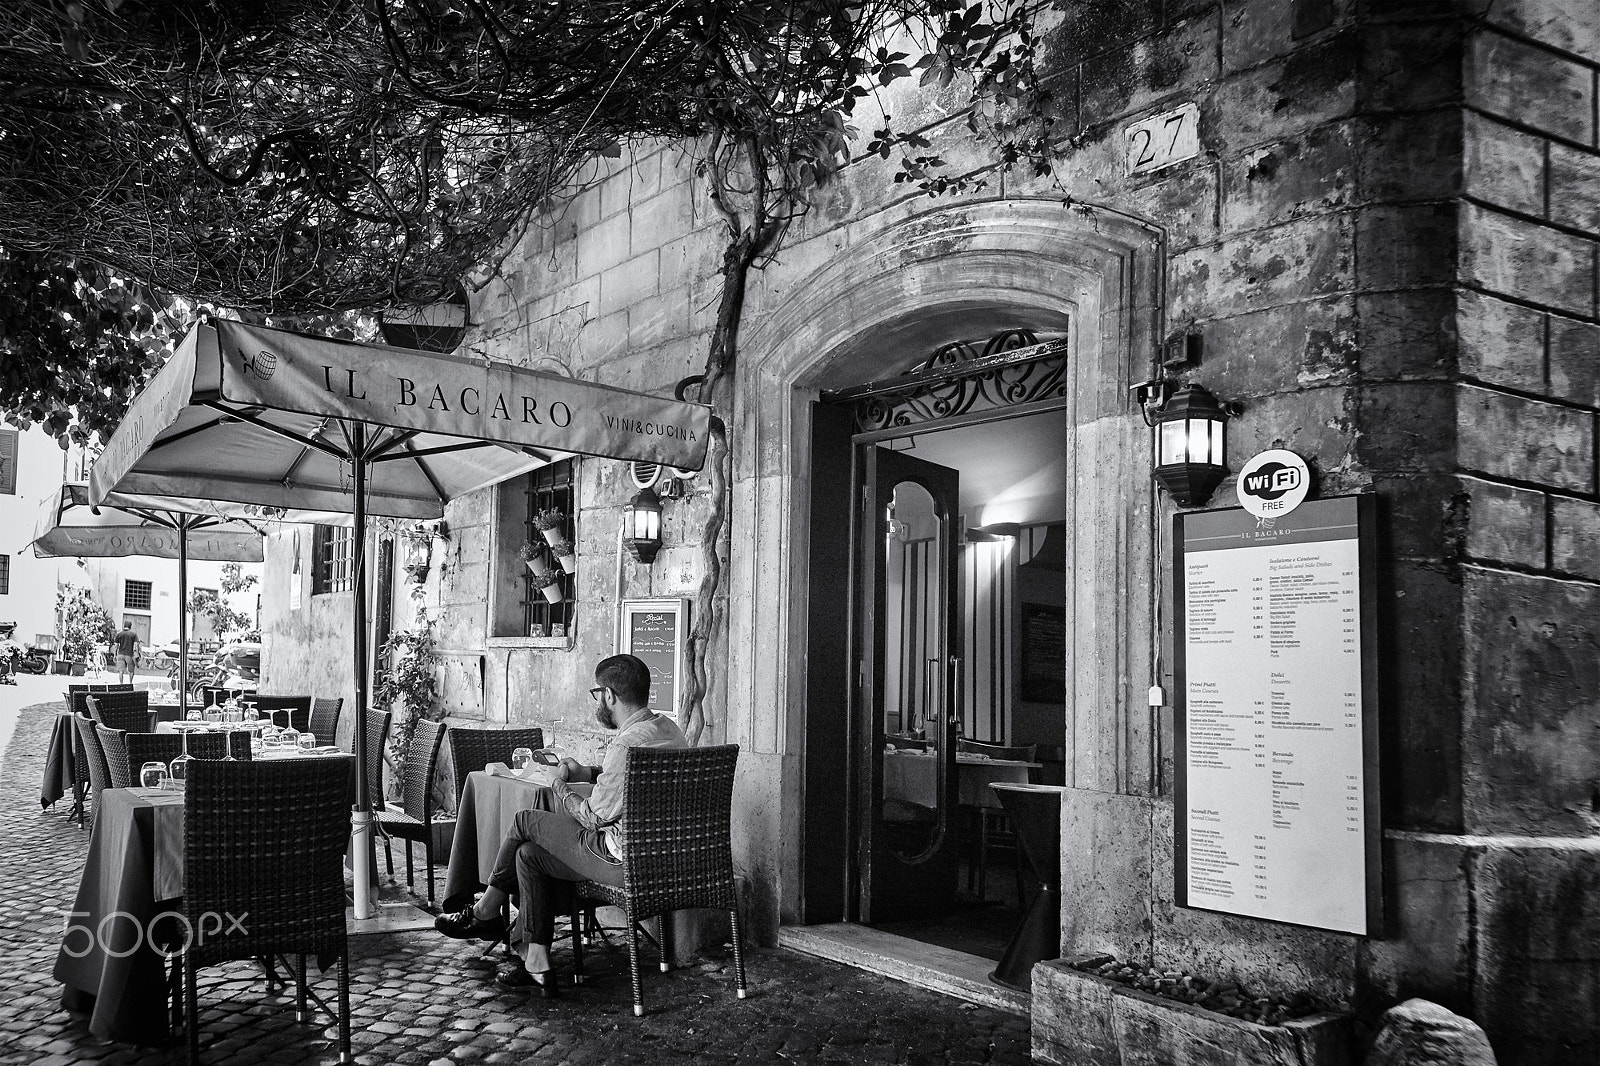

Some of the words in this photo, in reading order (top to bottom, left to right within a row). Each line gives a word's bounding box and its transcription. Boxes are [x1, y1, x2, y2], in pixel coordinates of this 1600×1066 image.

[1131, 112, 1186, 168] 27
[321, 365, 367, 400] IL
[397, 377, 573, 428] BACARO
[607, 415, 697, 442] VINI&CUCINA
[1262, 500, 1285, 511] FREE
[1255, 528, 1291, 538] BACARO
